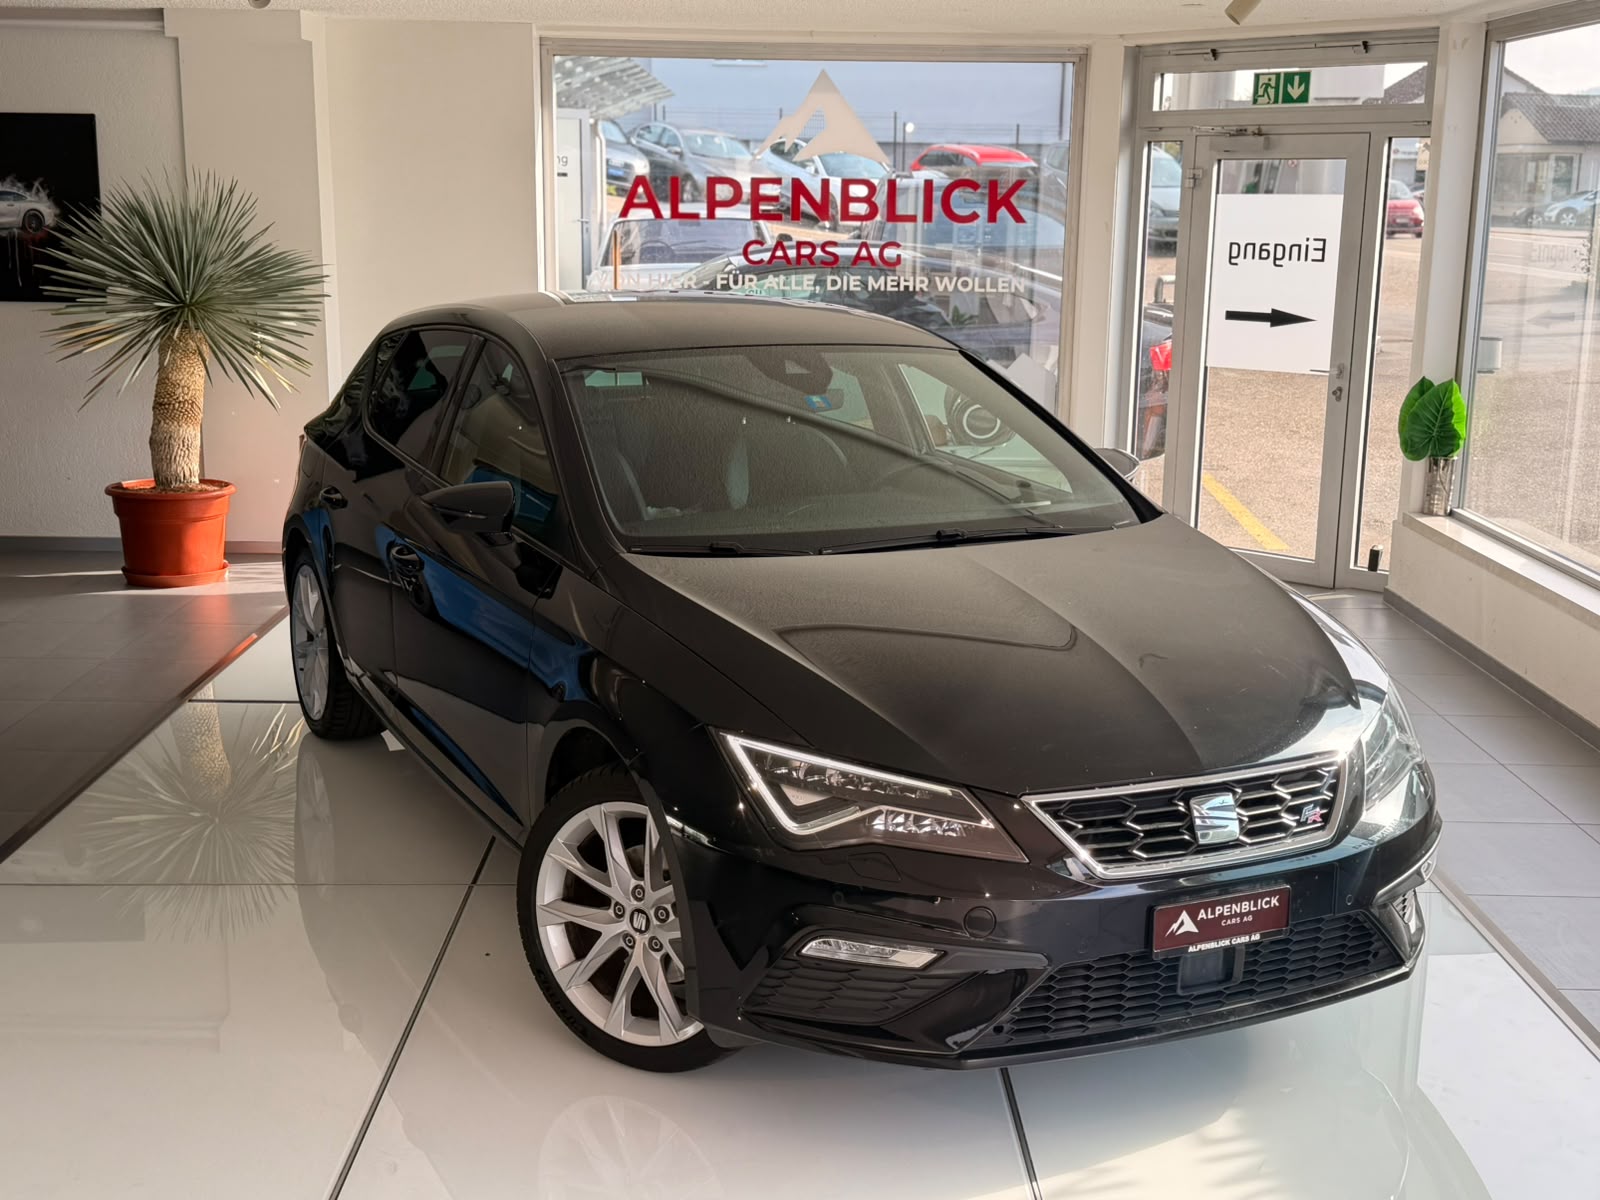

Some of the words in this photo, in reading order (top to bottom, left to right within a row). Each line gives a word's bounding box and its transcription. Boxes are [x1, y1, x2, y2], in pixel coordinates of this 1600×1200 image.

[619, 175, 1027, 225] ALPENBLICK
[742, 239, 839, 267] CARS
[851, 241, 903, 268] AG
[717, 270, 756, 290] FÜR
[763, 274, 820, 294] ALLE,
[827, 275, 861, 291] DIE
[868, 275, 929, 292] MEHR
[935, 276, 1025, 293] WOLLEN
[1197, 895, 1280, 920] ALPENBLICK
[1221, 917, 1241, 927] CARS
[1188, 939, 1231, 953] ALPENBLICK
[1232, 936, 1250, 945] CARS
[1251, 933, 1261, 941] AG
